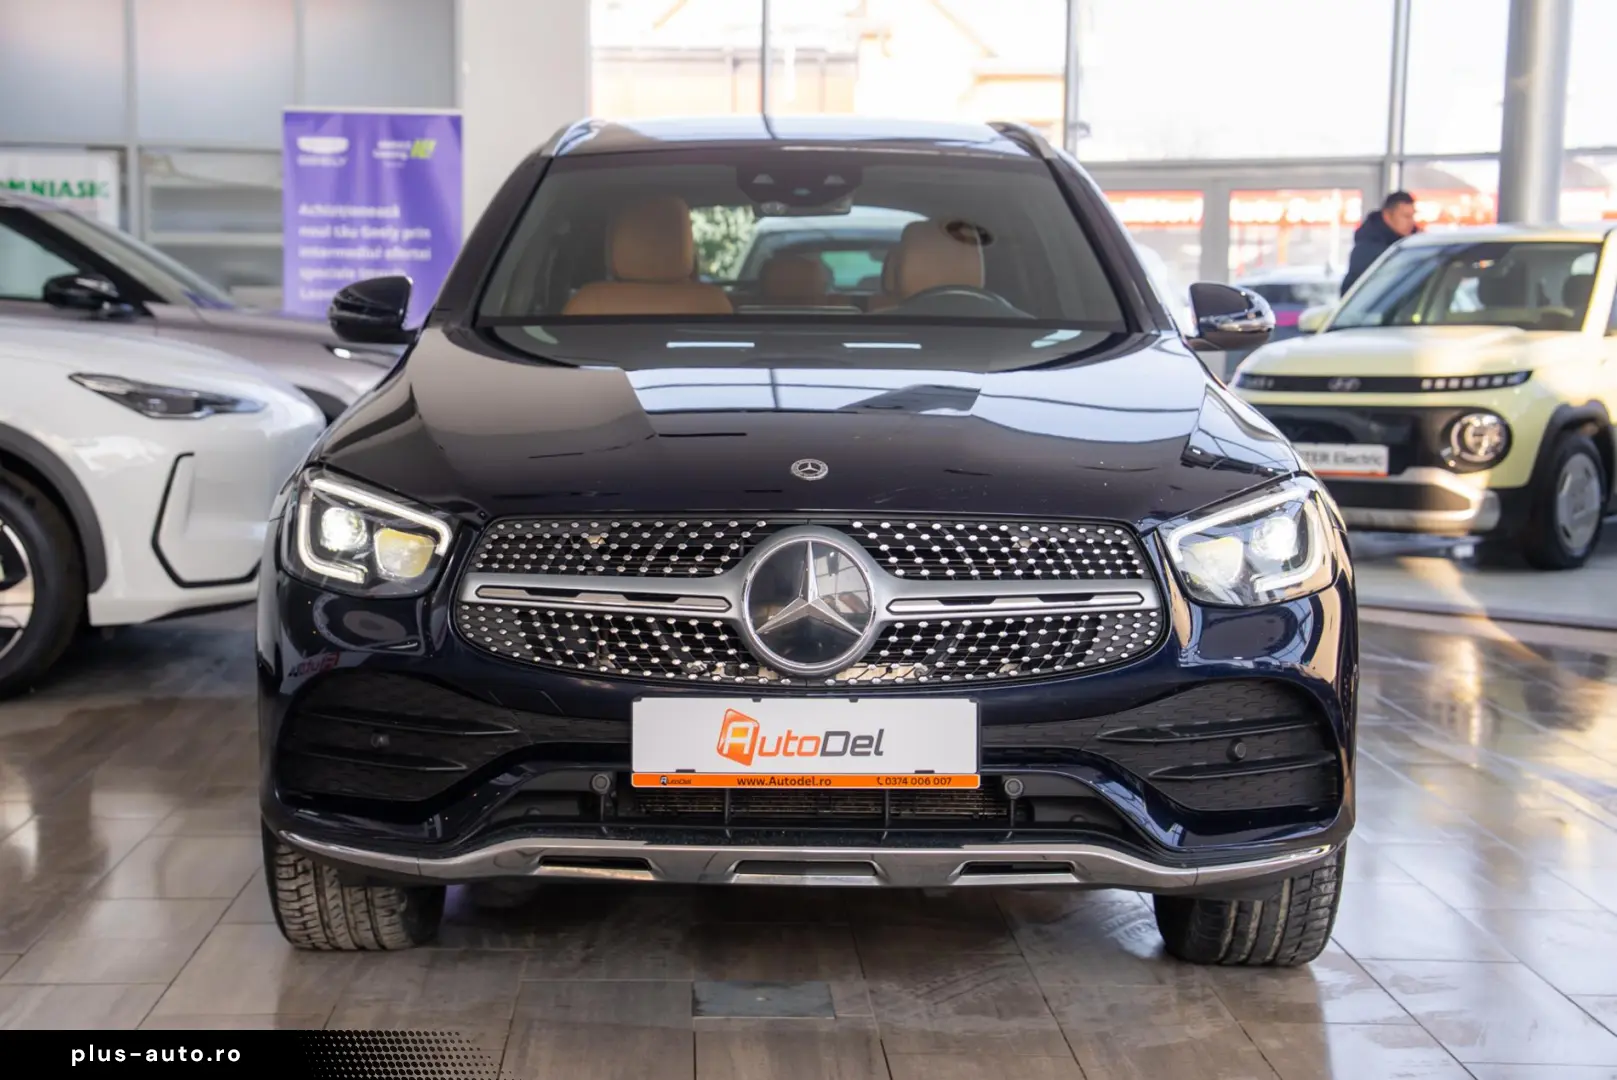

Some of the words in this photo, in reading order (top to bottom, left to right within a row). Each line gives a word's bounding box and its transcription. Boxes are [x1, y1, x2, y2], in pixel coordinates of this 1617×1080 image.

[719, 715, 884, 760] AutoDel
[736, 776, 832, 787] www.Autodel.ro
[885, 776, 908, 786] 0374
[911, 776, 931, 786] 006
[933, 776, 952, 785] 007
